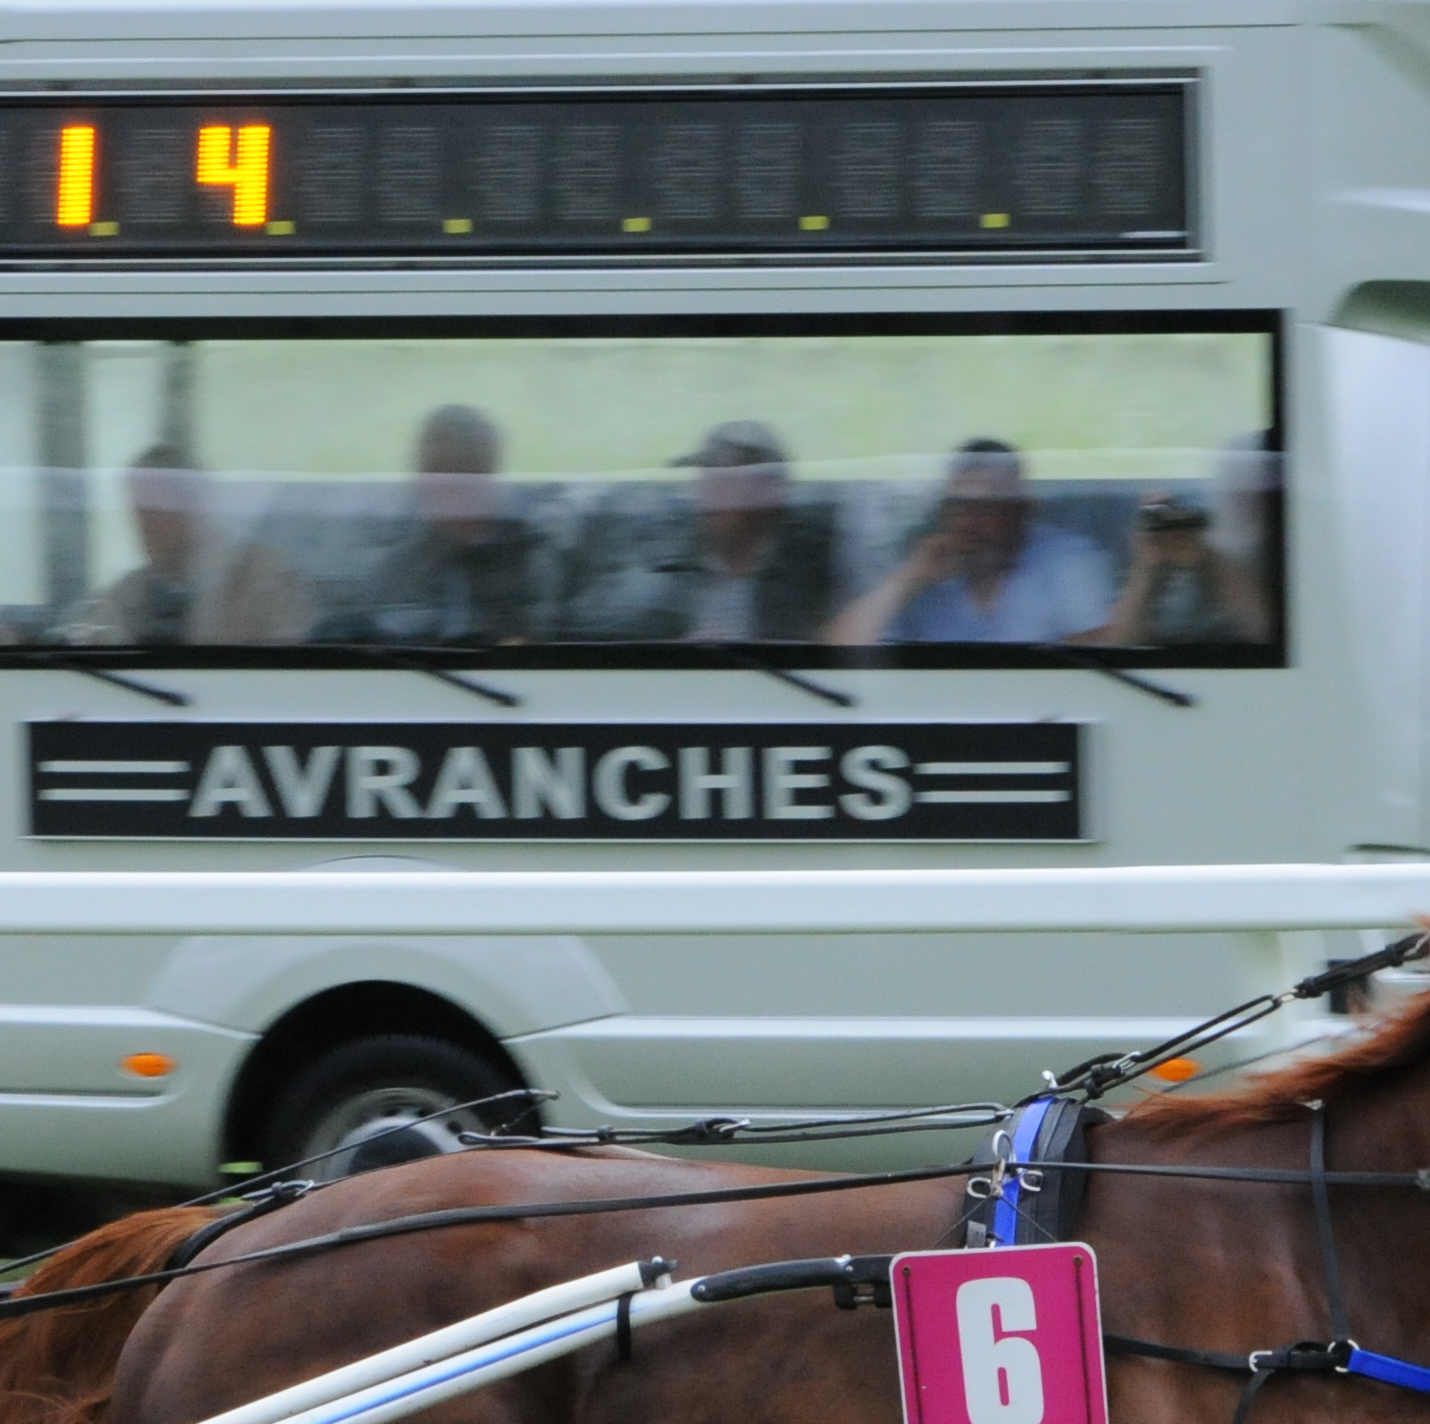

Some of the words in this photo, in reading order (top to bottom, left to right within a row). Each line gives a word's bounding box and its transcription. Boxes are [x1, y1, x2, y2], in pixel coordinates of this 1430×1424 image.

[56, 125, 95, 225] 1
[197, 125, 271, 225] 4
[187, 744, 914, 821] AVRANCHES
